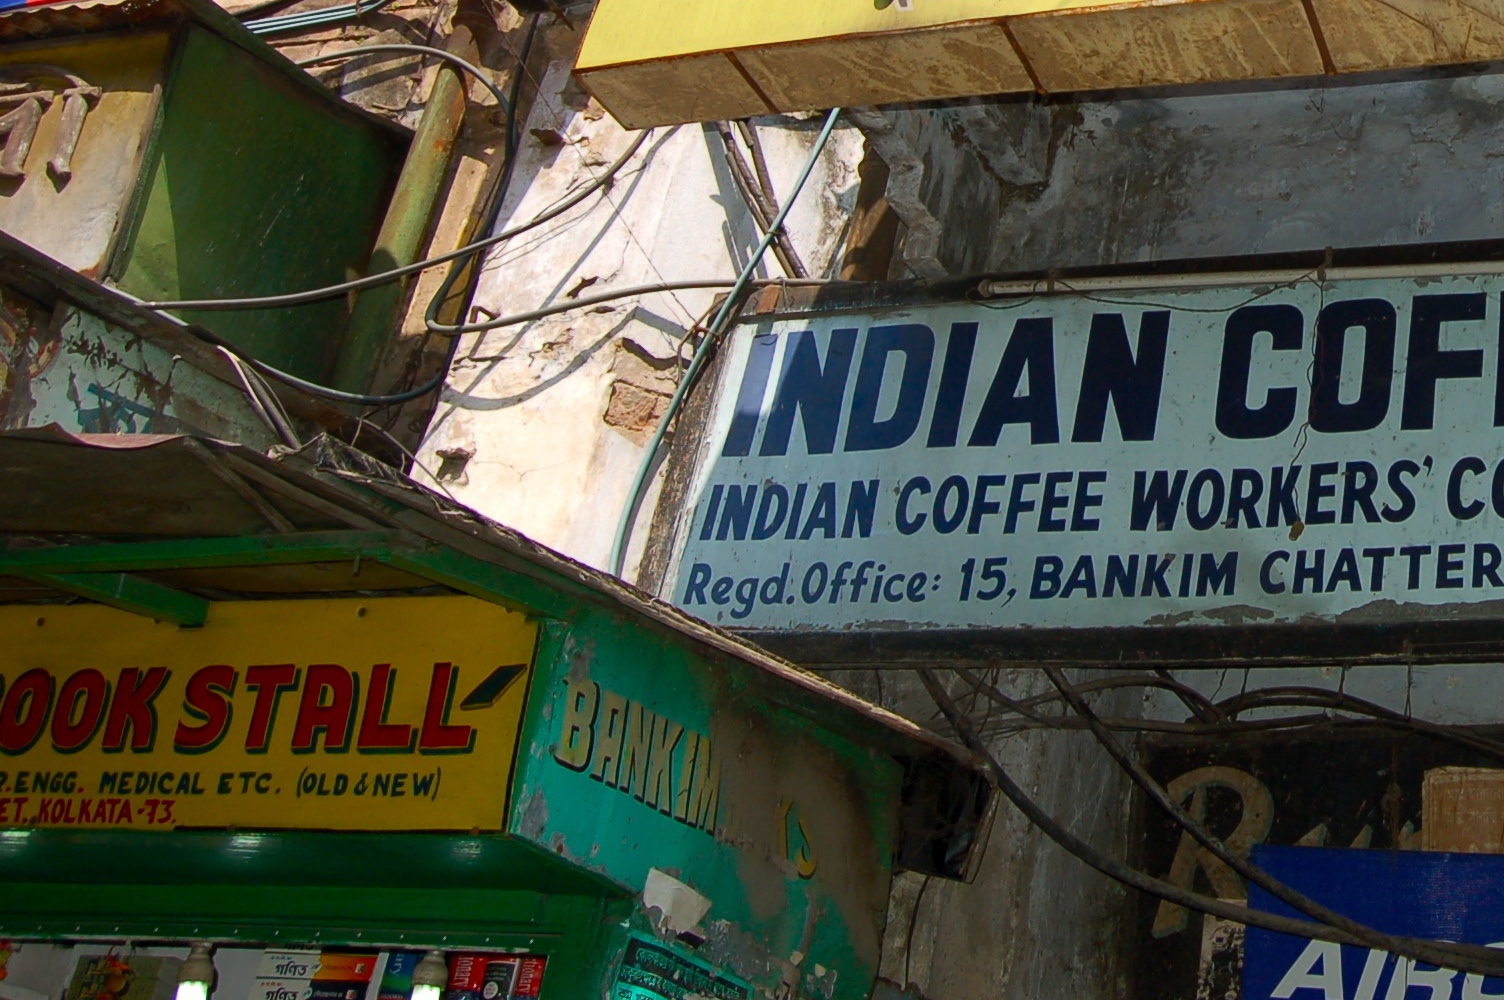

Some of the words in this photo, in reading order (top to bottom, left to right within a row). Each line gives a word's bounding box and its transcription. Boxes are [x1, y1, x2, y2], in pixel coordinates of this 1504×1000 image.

[722, 310, 1171, 458] INDIAN
[700, 479, 878, 541] INDIAN
[896, 471, 1106, 537] COFFEE
[1130, 456, 1434, 533] WORKERS'
[958, 556, 1017, 608] 15,
[1029, 551, 1238, 600] BANKIM
[0, 666, 170, 754] OOK
[174, 661, 478, 754] STALL
[98, 771, 205, 796] MEDICAL
[217, 771, 281, 795] ETC.
[553, 678, 720, 838] BANKIM
